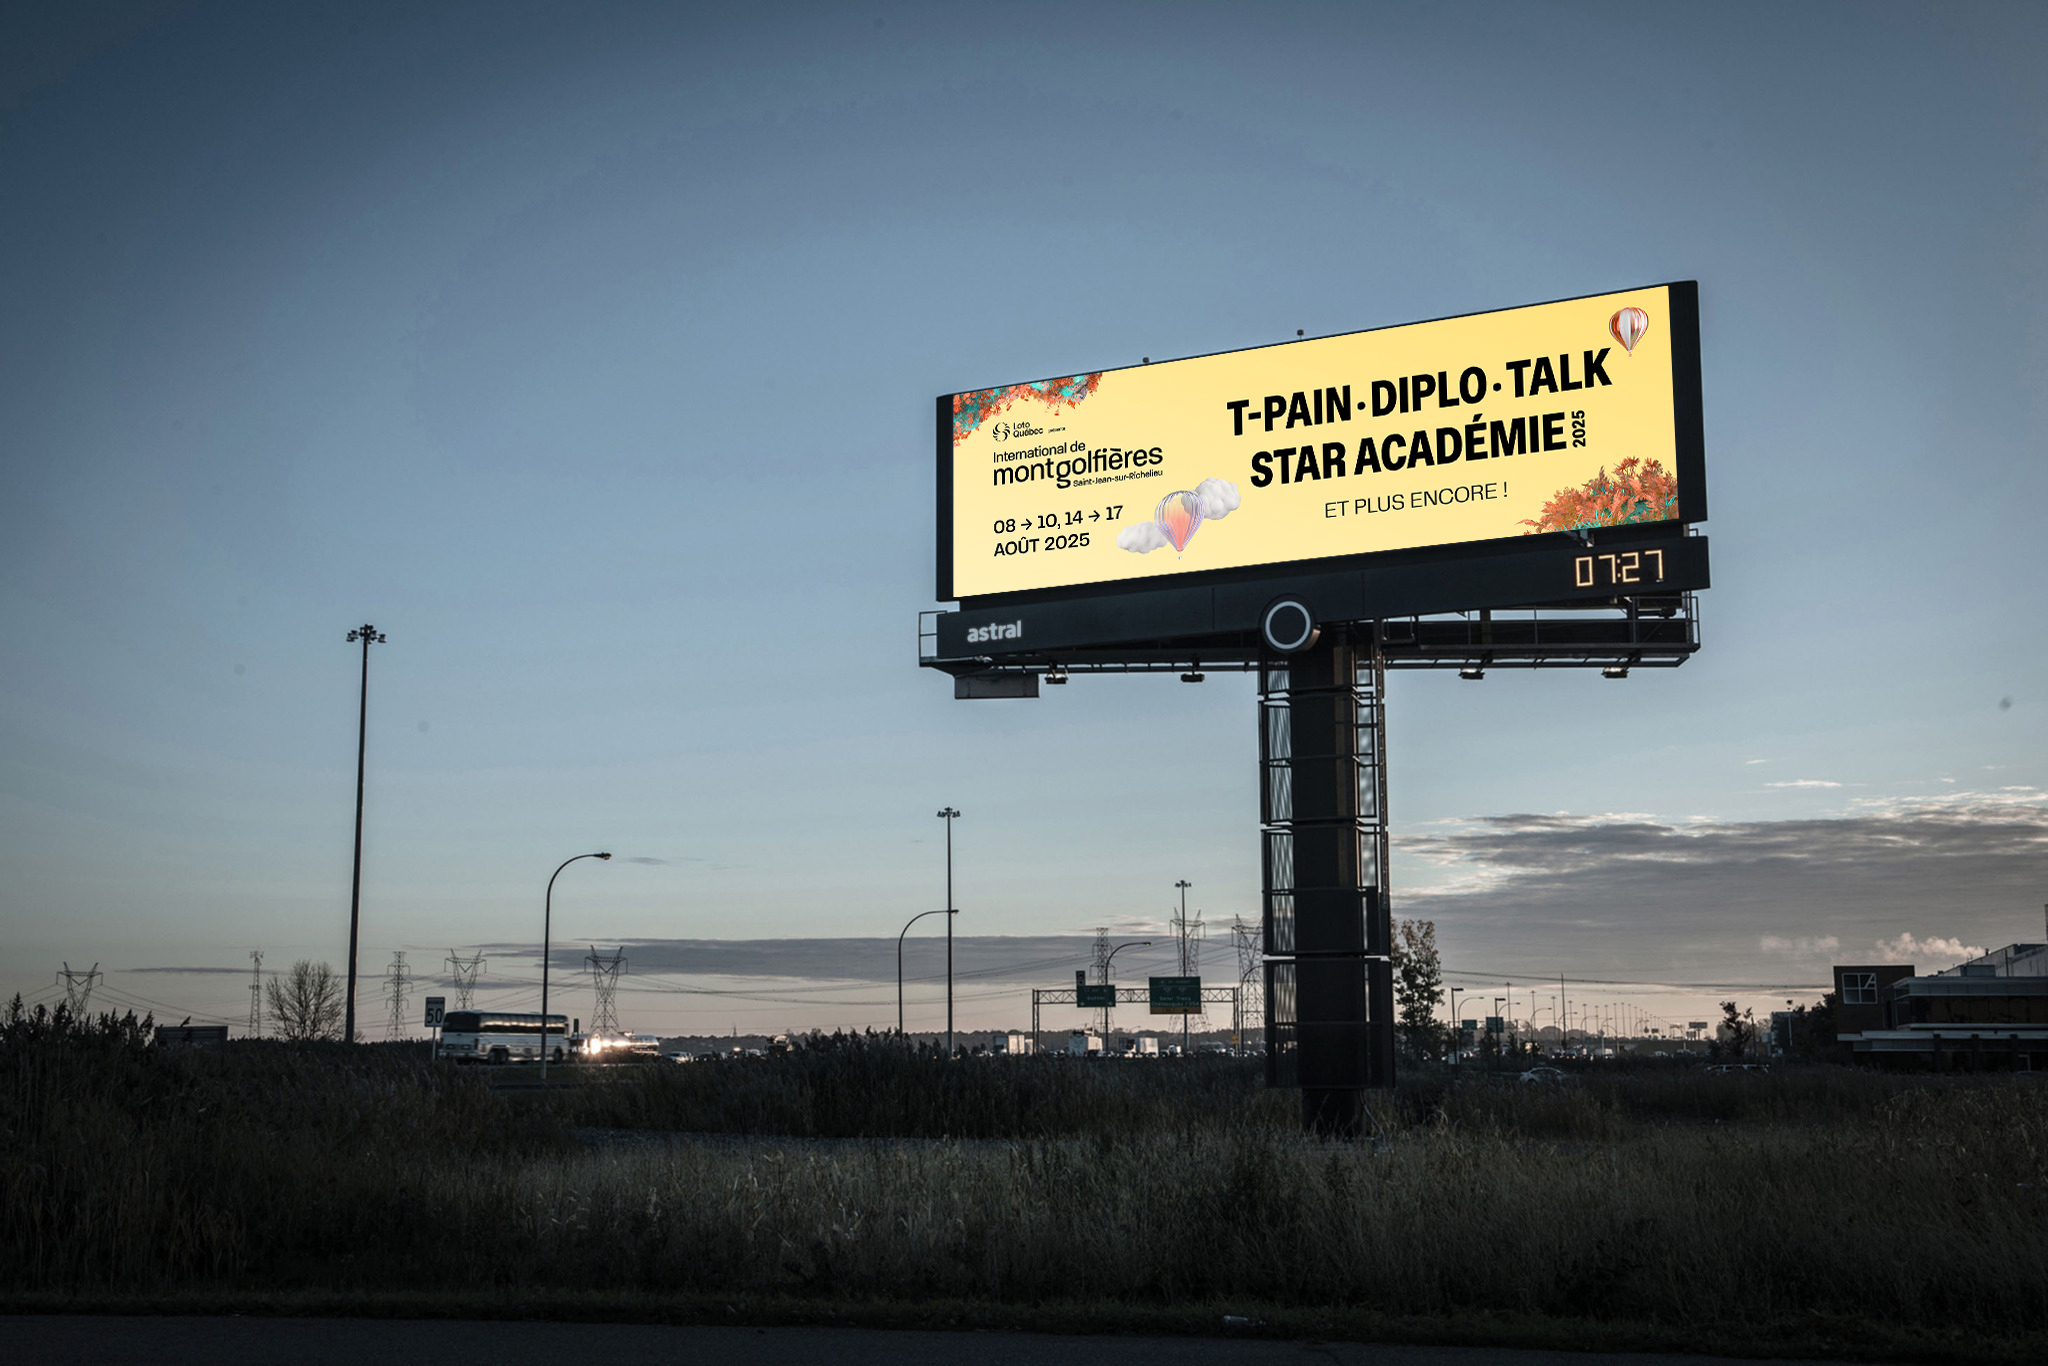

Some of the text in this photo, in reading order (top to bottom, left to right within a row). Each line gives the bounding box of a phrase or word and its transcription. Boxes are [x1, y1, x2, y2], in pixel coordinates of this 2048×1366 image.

[1227, 347, 1612, 436] T-PAIN DIPLO TALK
[1013, 422, 1030, 430] Loto
[1571, 410, 1586, 448] 2025
[994, 441, 1085, 463] International de
[1250, 412, 1567, 488] STAR ACADÉMIE
[994, 447, 1163, 489] montgolfières
[1073, 469, 1163, 487] Saint-Jean-sur-Richelieu
[1325, 501, 1349, 518] ET
[1355, 494, 1404, 514] PLUS
[1411, 483, 1497, 508] ENCORE
[994, 505, 1123, 534] 08 10, 14 17
[994, 532, 1090, 556] AOÛT 2025
[1575, 549, 1663, 587] 07:27
[967, 620, 1021, 642] astral
[427, 1008, 442, 1023] 50
